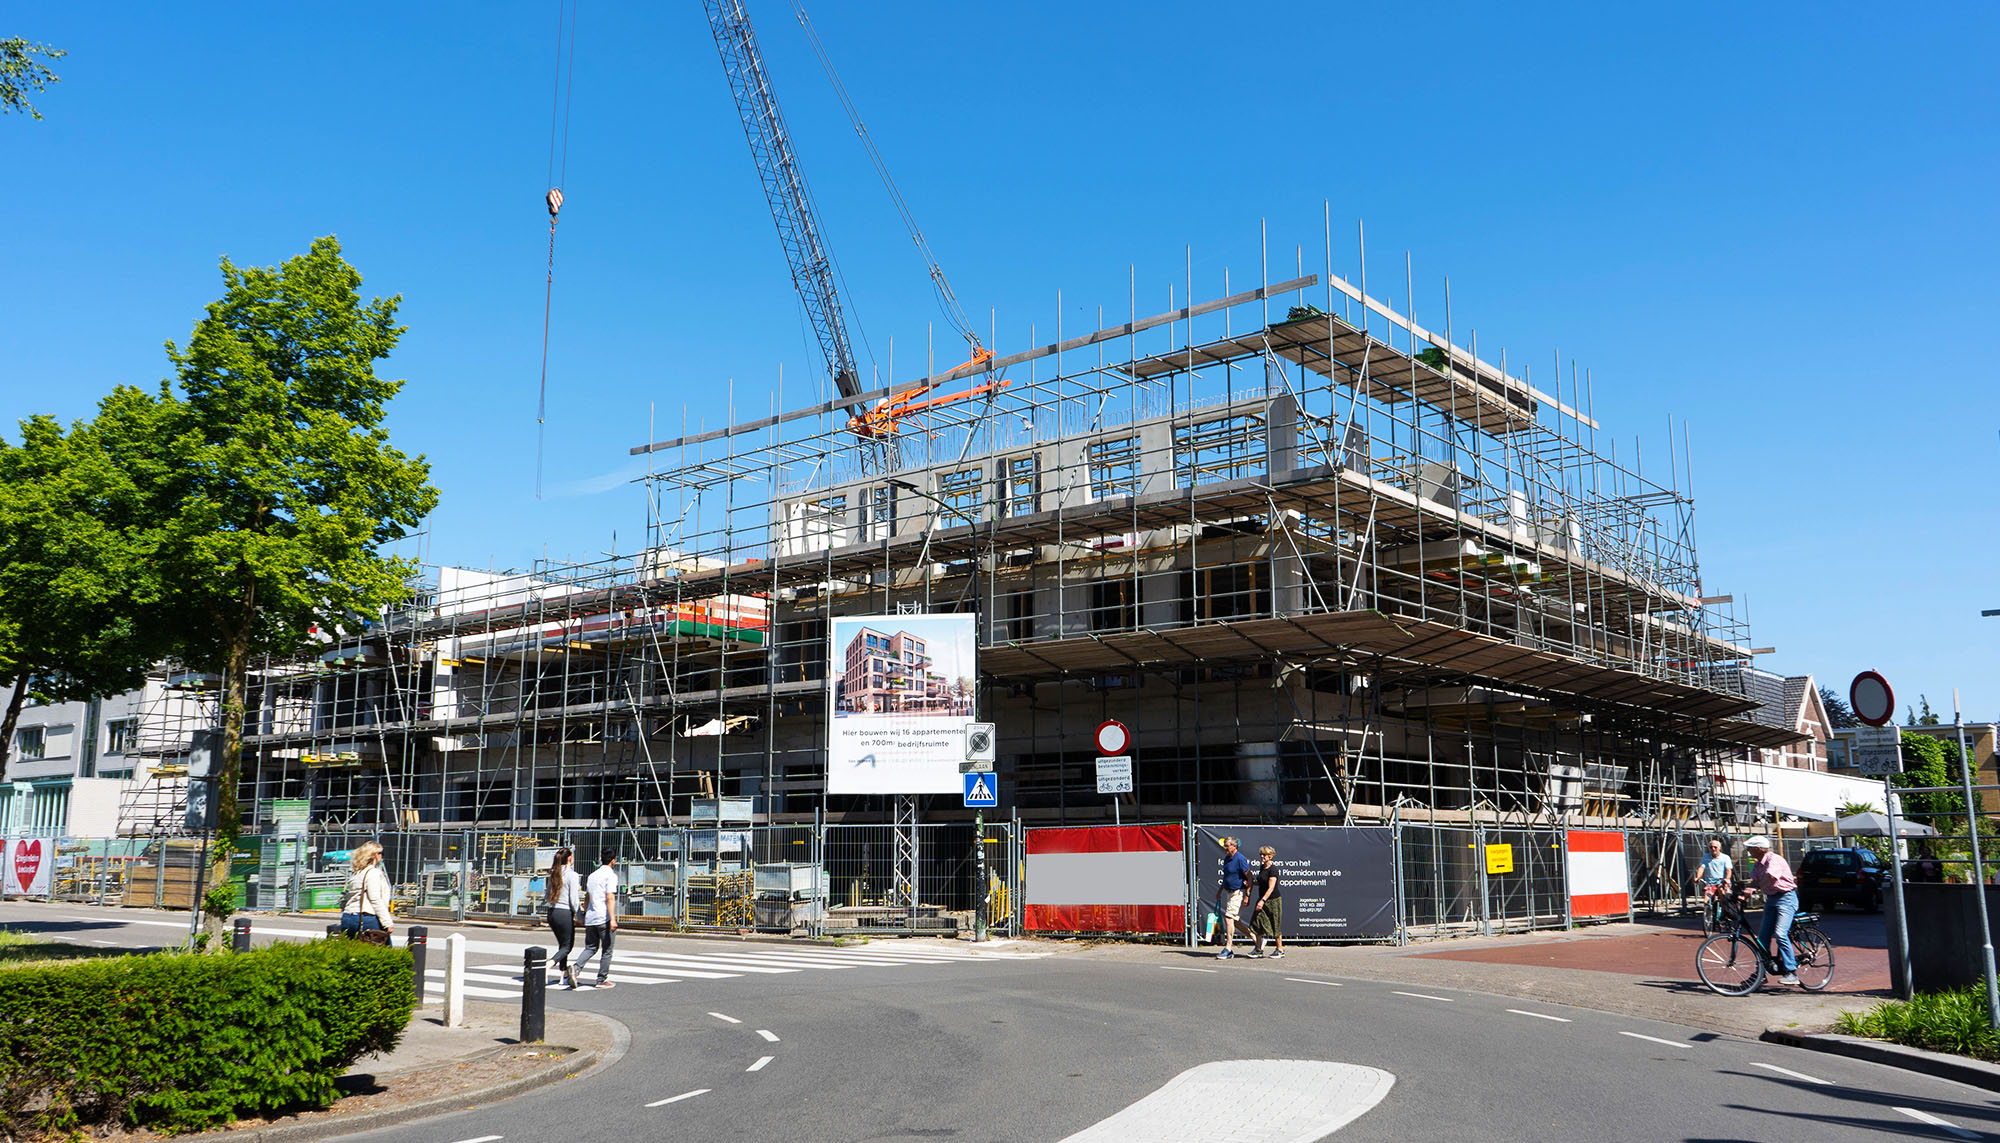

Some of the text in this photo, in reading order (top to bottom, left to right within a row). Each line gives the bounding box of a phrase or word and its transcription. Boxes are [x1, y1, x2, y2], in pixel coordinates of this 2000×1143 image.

[890, 729, 901, 737] wij
[1250, 859, 1261, 867] de
[1298, 859, 1311, 867] het
[1331, 869, 1342, 877] de
[1279, 878, 1327, 887] appartement!
